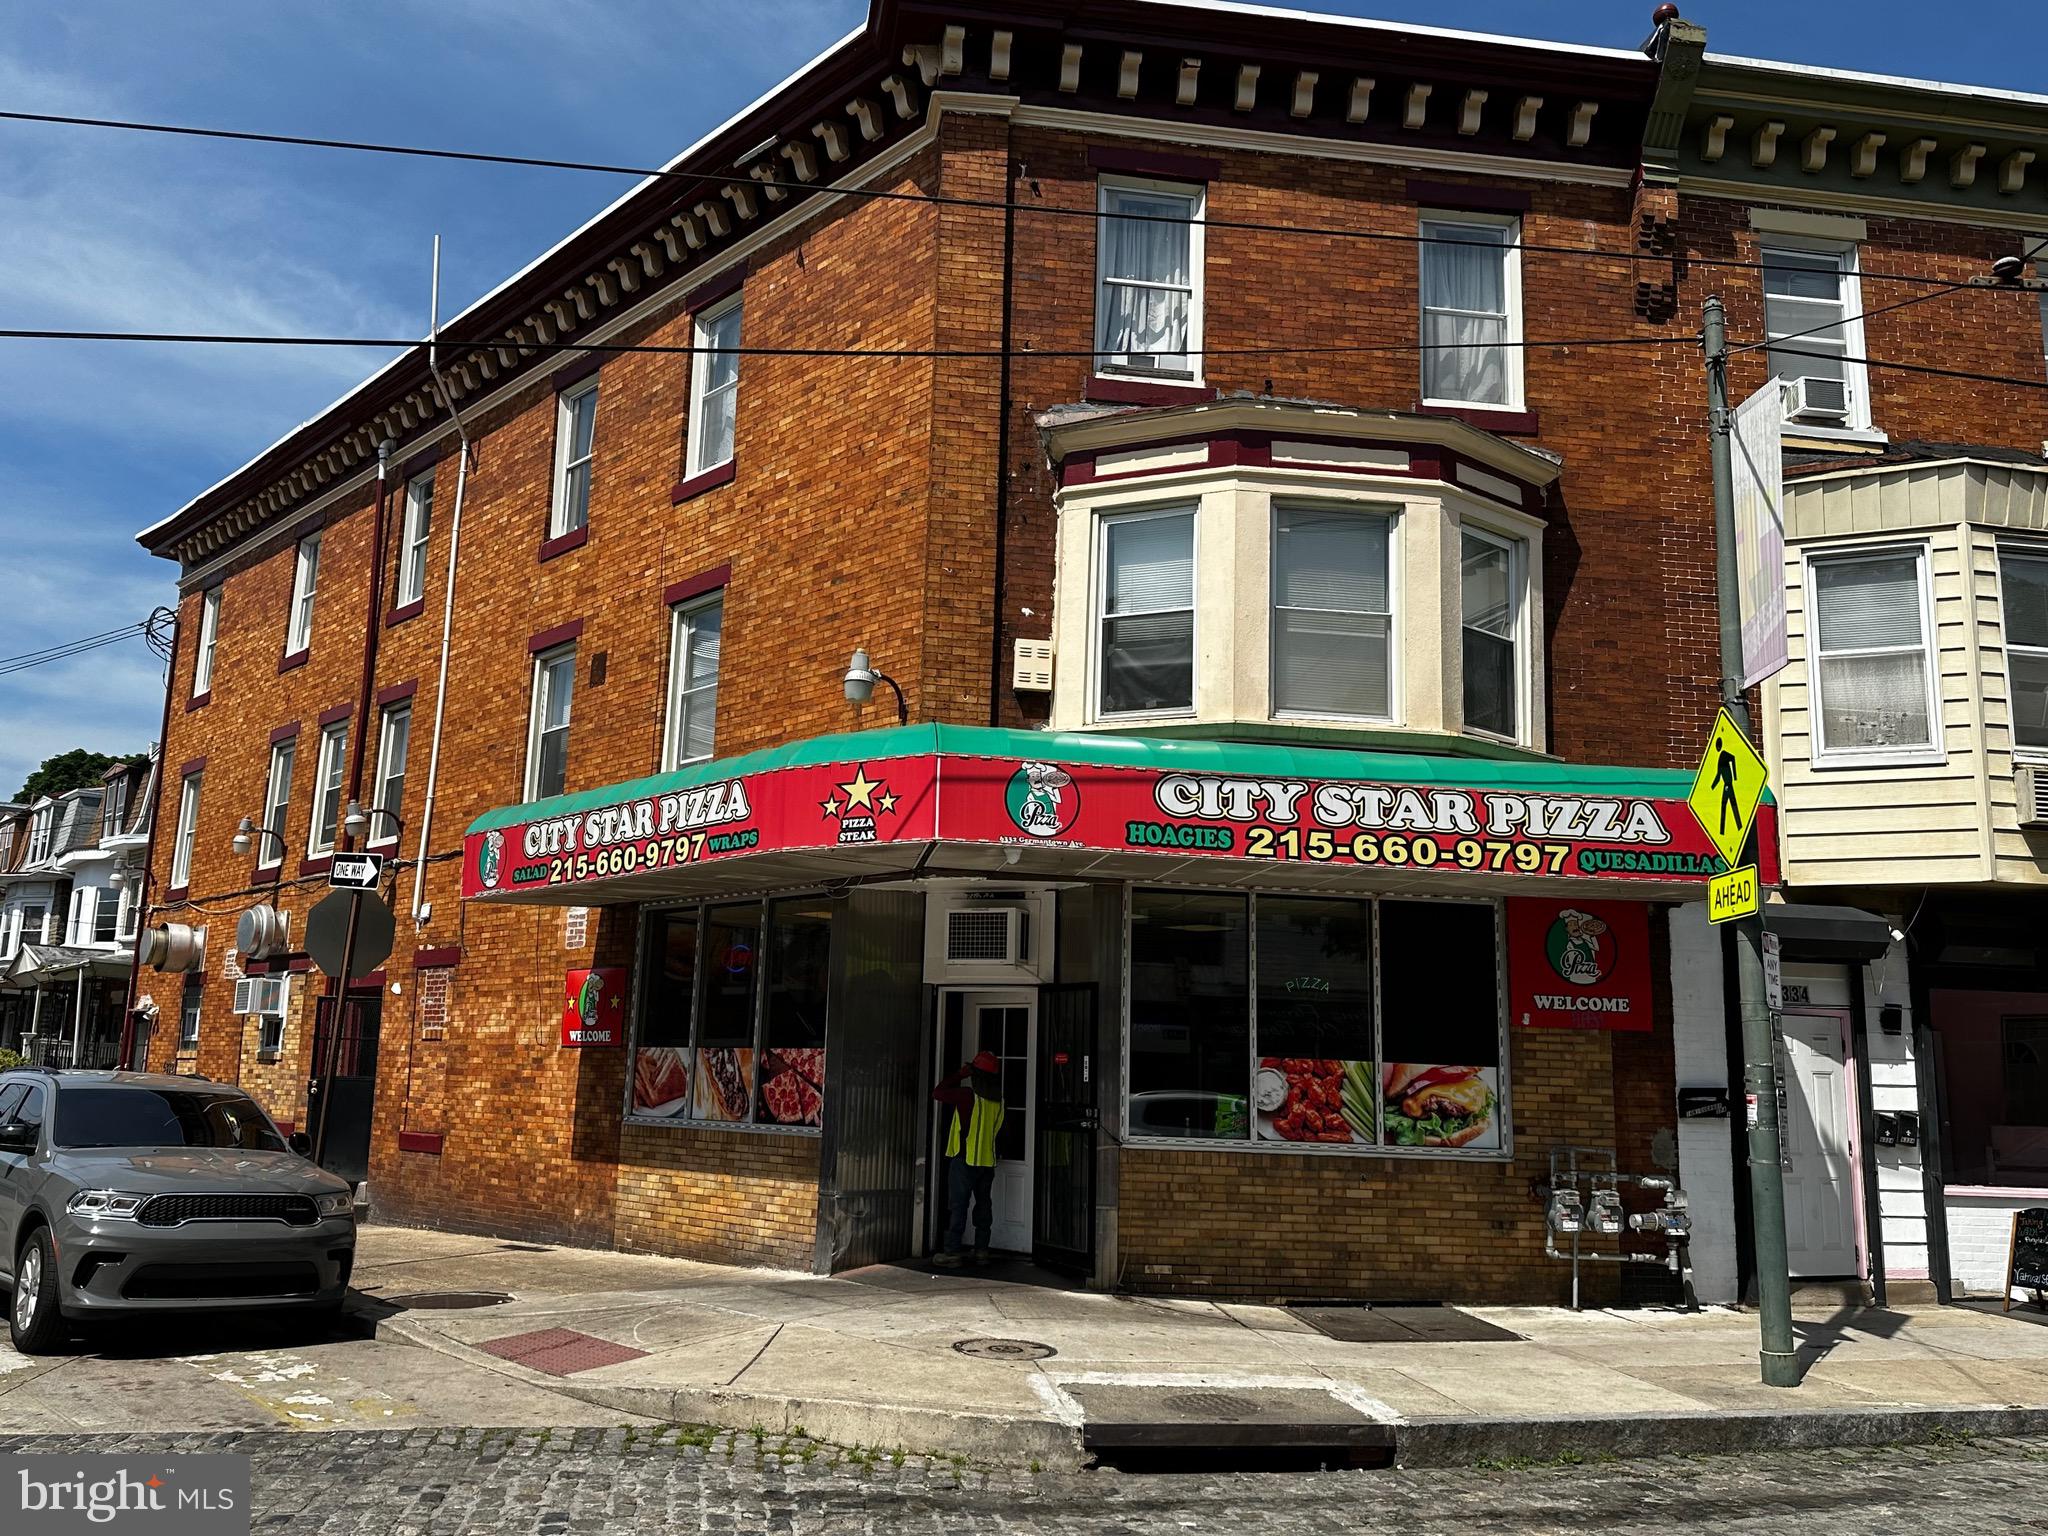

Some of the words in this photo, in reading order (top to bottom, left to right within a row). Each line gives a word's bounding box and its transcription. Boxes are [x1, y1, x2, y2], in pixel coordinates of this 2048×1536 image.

[1020, 801, 1063, 829] Pizza
[1155, 775, 1306, 821] CITY
[1312, 781, 1480, 836] STAR
[1484, 793, 1670, 844] PIZZA
[524, 816, 582, 858] CITY
[584, 806, 658, 848] STAR
[660, 780, 750, 831] PIZZA
[840, 817, 875, 830] PIZZA
[838, 828, 877, 842] STEAK
[1019, 837, 1068, 847] Germantown
[513, 865, 548, 882] SALAD
[550, 834, 706, 882] 215-660-9797
[708, 830, 758, 853] WRAPS
[1127, 821, 1233, 851] HOAGIES
[1248, 828, 1569, 872] 215-660-9797
[1579, 849, 1728, 875] QUESADILLAS
[336, 864, 349, 877] ONE
[352, 864, 366, 878] WAY
[1714, 878, 1751, 911] AHEAD
[1561, 950, 1602, 978] Pizza
[1767, 959, 1778, 971] ANY
[1286, 976, 1329, 994] PIZZA
[1768, 973, 1779, 986] TIME
[1533, 994, 1630, 1012] WELCOME
[569, 1029, 611, 1042] WELCOME
